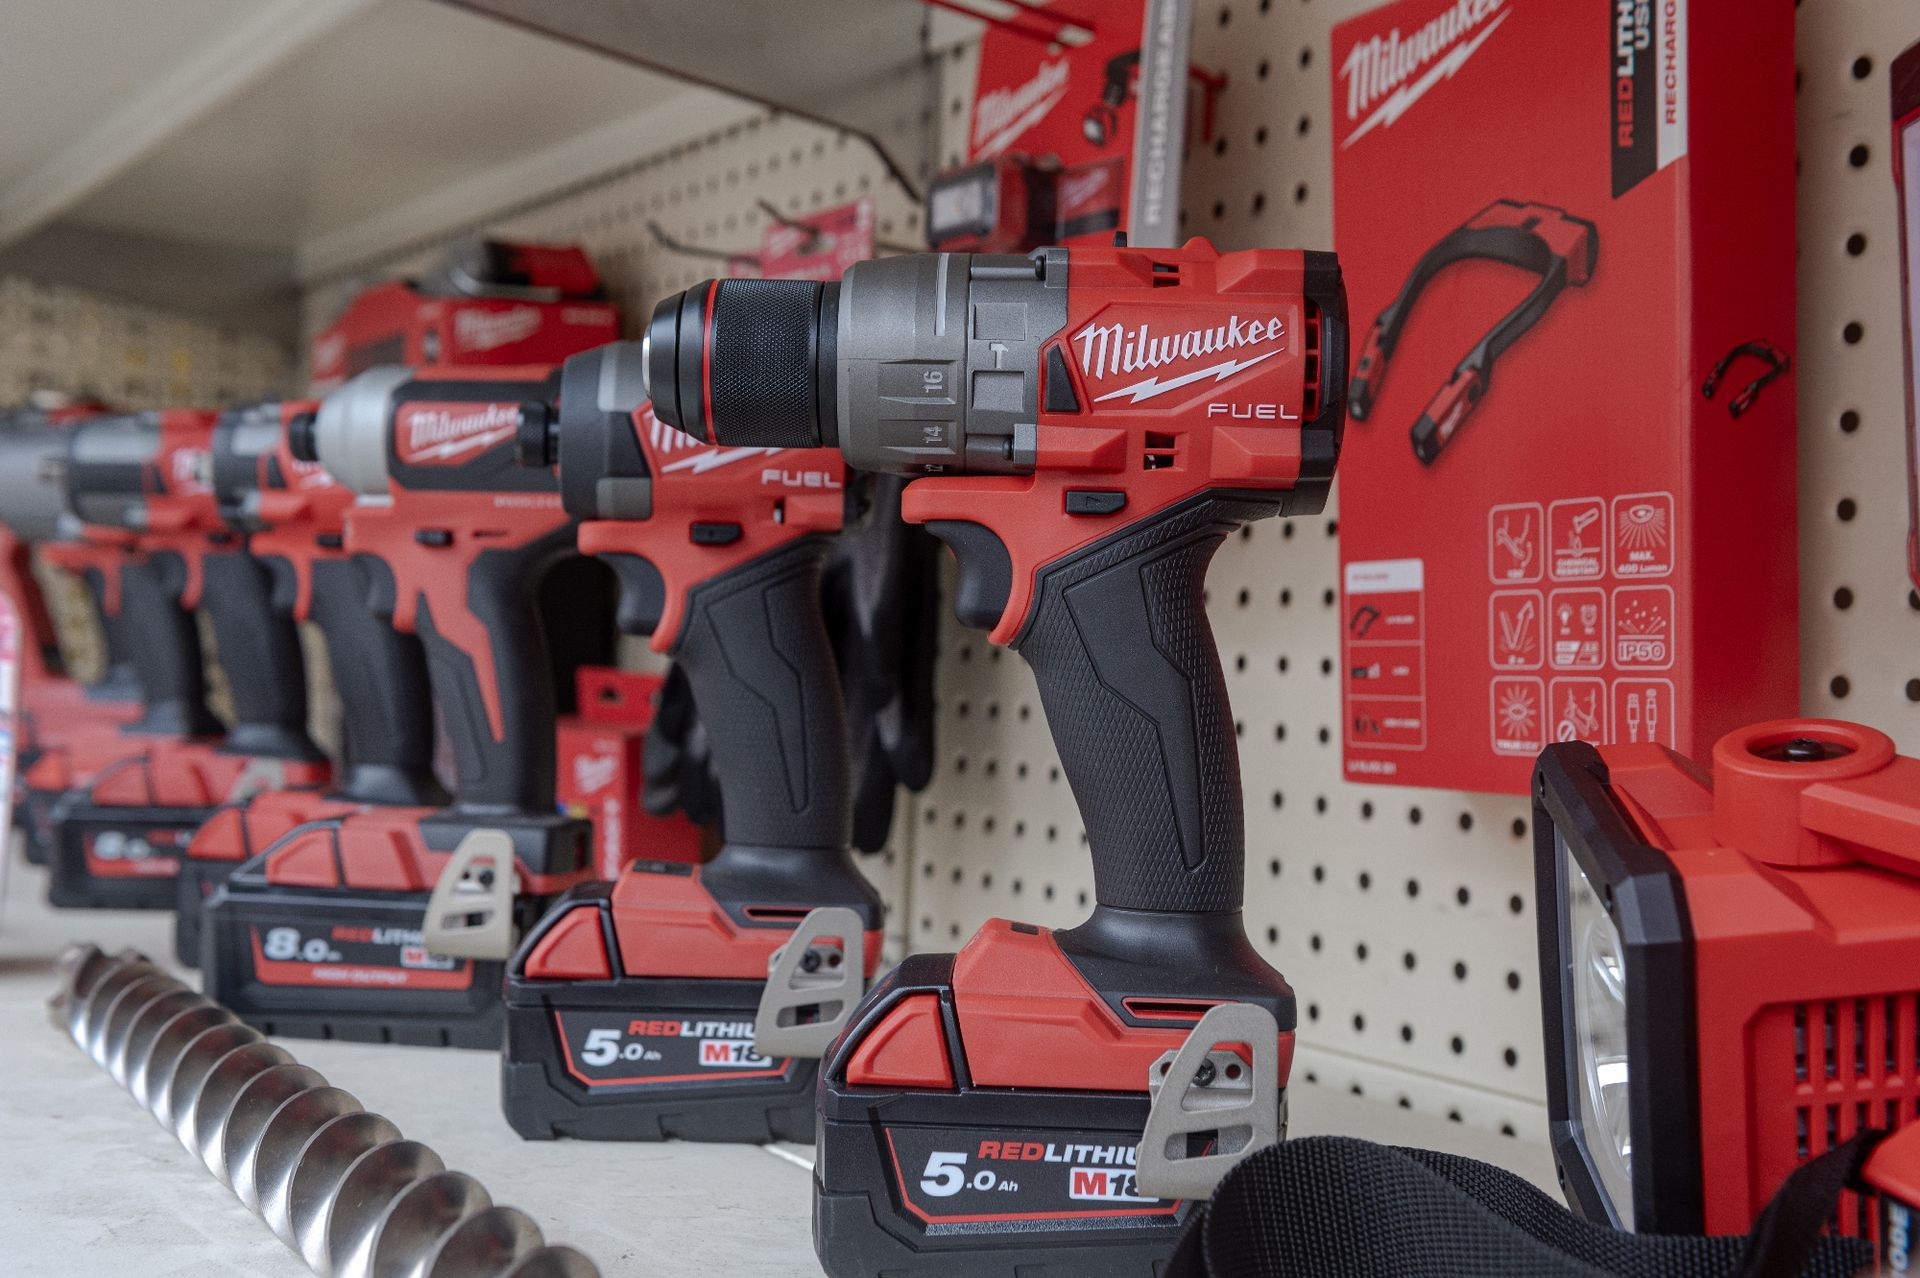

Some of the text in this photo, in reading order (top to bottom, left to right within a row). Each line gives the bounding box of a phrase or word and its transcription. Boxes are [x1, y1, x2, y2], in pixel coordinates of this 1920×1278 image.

[1635, 0, 1651, 51] US
[1338, 0, 1501, 120] Milwauke
[1073, 315, 1286, 381] Milwaukee
[922, 370, 943, 393] 16
[1207, 403, 1299, 420] FUEL
[922, 425, 943, 443] 14
[761, 469, 842, 489] FUEL
[1618, 642, 1666, 662] IP50
[581, 1029, 645, 1067] 5.0
[920, 1151, 1019, 1197] 5.0 Ah
